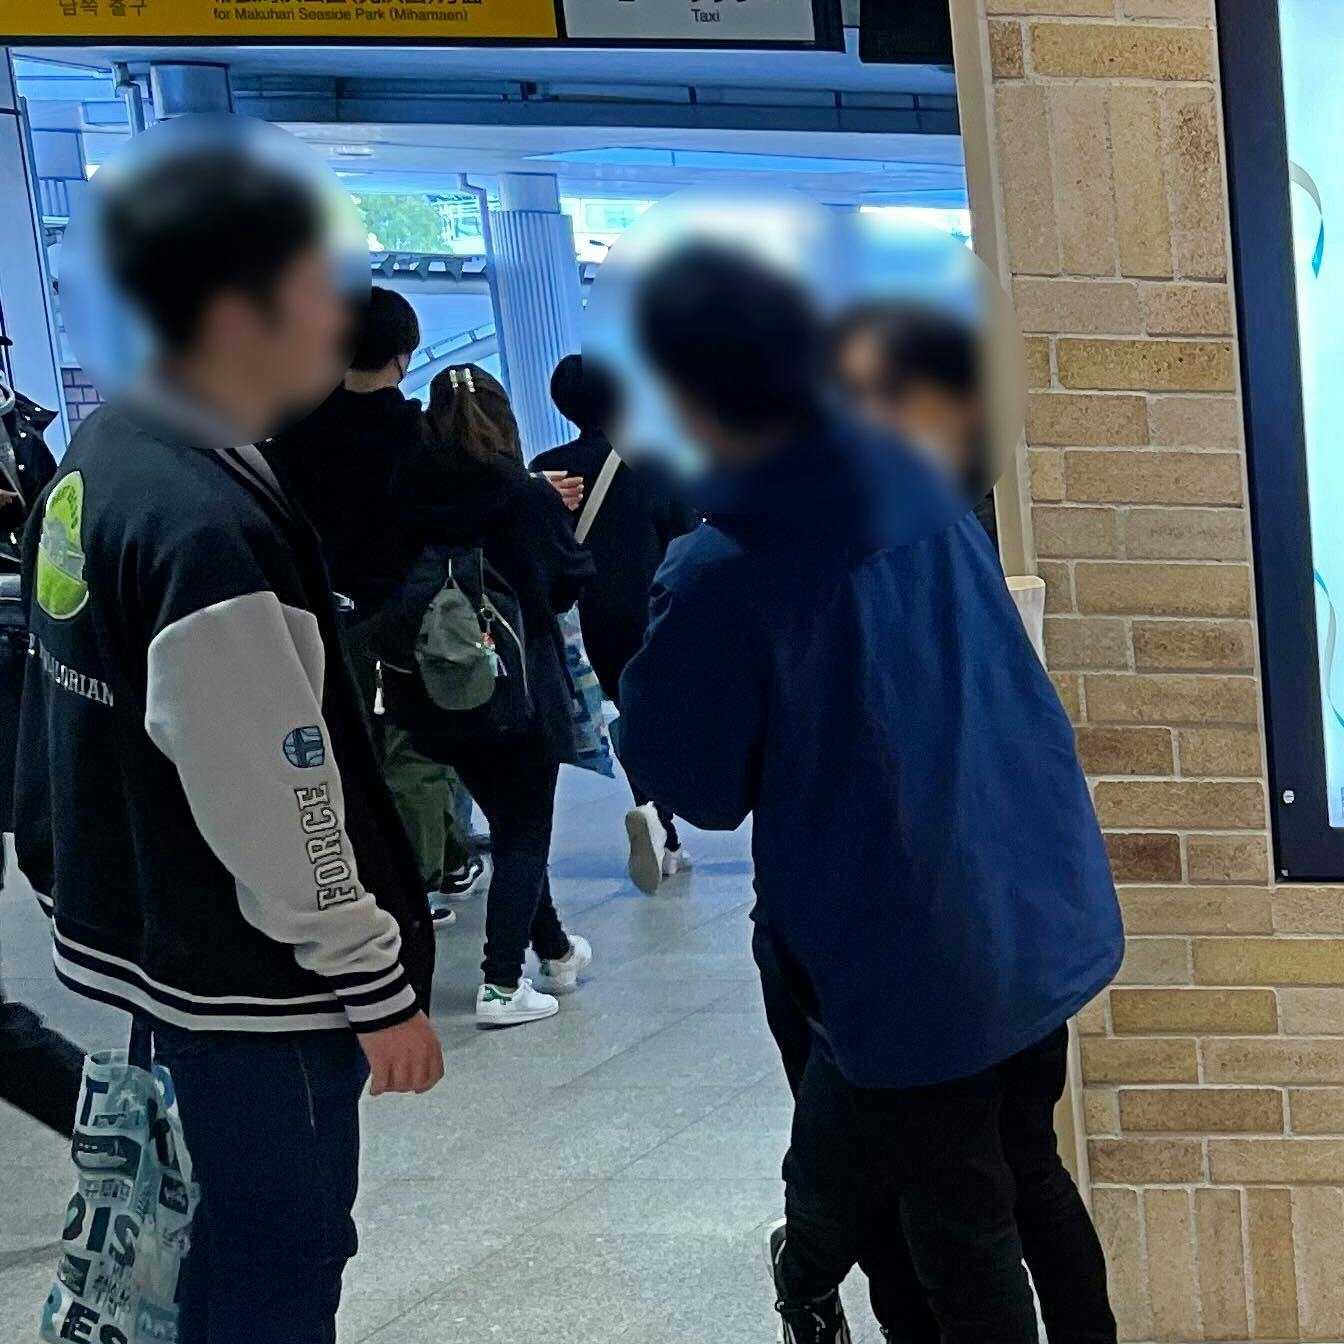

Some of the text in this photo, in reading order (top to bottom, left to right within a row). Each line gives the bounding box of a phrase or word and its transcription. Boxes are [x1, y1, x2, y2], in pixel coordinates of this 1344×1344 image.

[214, 8, 230, 20] for
[234, 8, 295, 21] Makuhari
[299, 8, 351, 21] Seaside
[355, 8, 386, 21] Park
[691, 8, 720, 23] Taxi
[294, 782, 359, 911] FORCE
